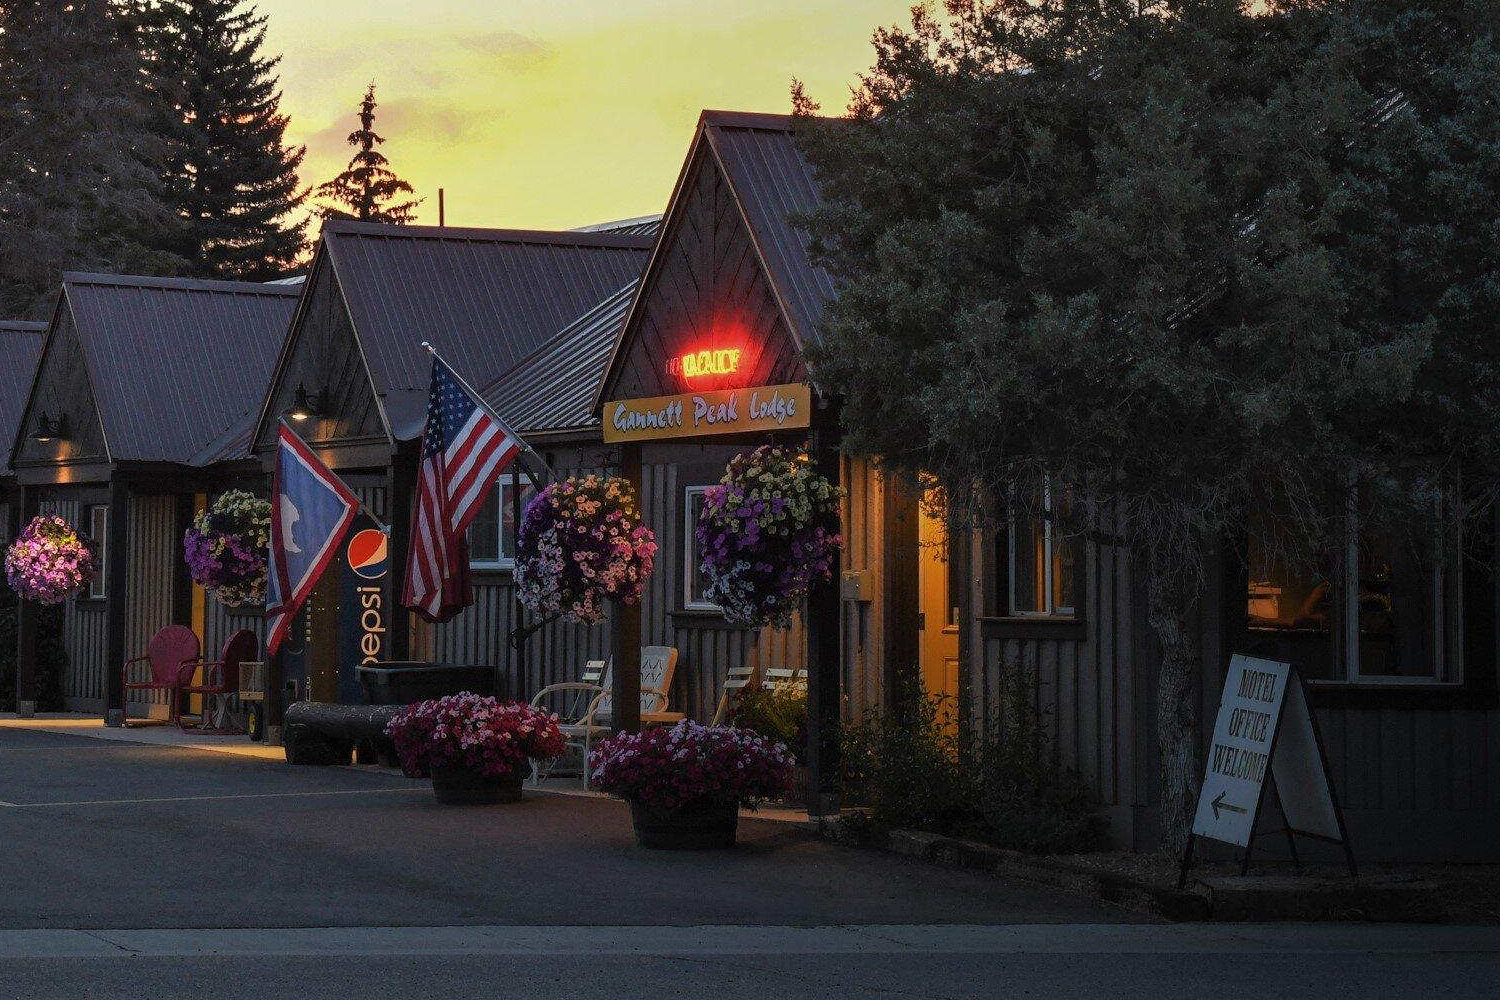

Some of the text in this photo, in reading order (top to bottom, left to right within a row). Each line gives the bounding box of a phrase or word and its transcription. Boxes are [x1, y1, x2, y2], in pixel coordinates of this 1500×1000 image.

[613, 390, 796, 431] Gannett Peak Lodge
[1237, 669, 1277, 703] MOTEL
[1228, 708, 1271, 743] OFFICE
[1212, 744, 1268, 783] WELCOME
